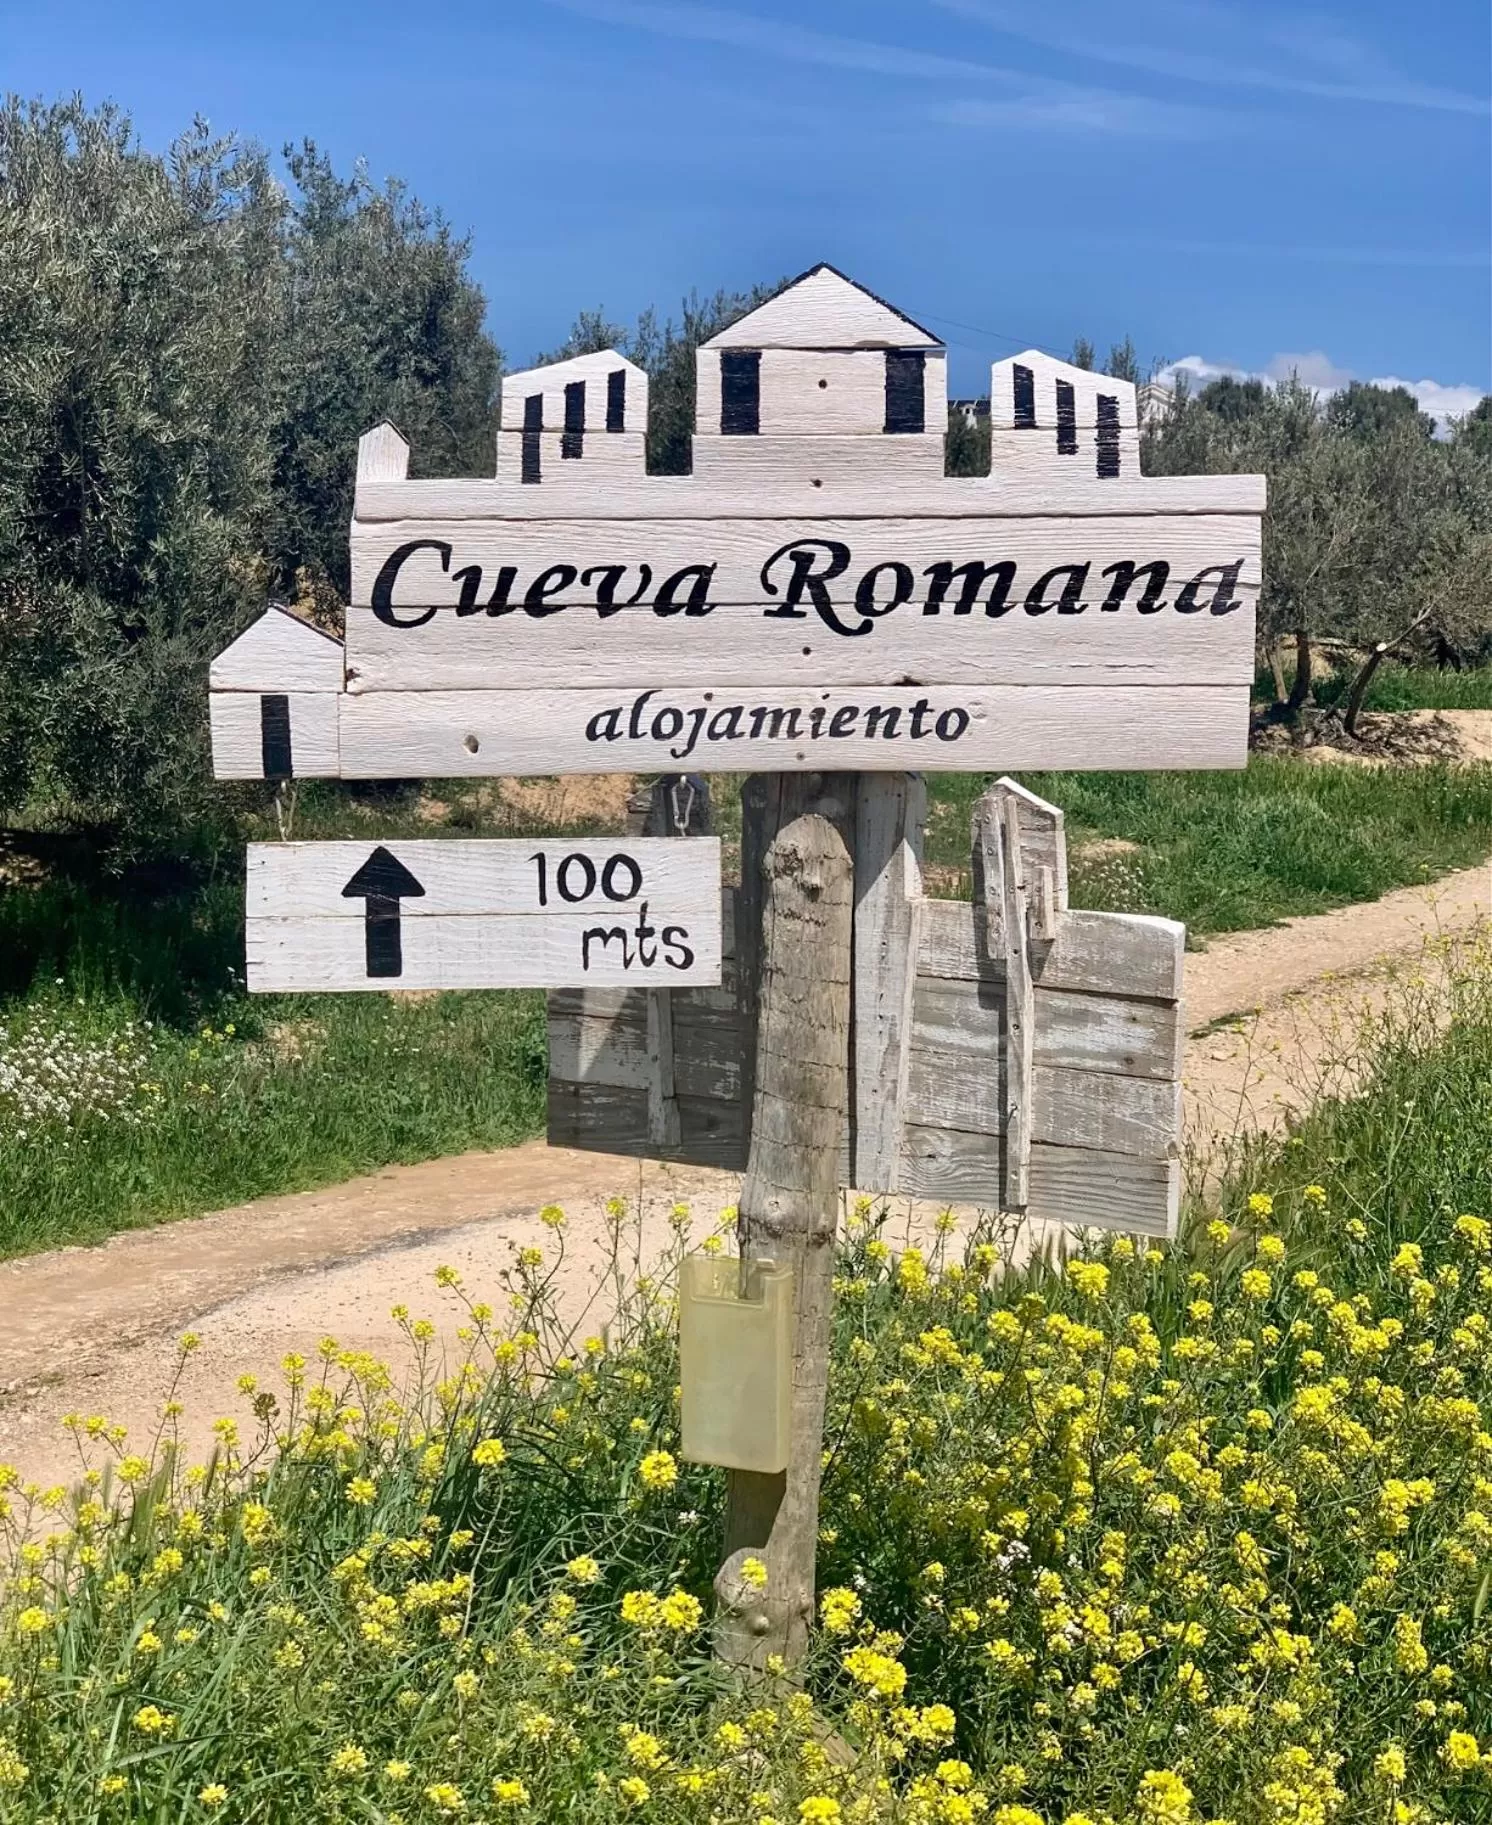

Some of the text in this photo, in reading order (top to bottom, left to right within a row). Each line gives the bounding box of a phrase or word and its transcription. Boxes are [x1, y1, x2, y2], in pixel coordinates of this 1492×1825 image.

[371, 538, 1245, 636] Cueva Romana
[586, 689, 970, 758] alojamiento
[528, 852, 643, 906] 100
[582, 901, 694, 971] mts
